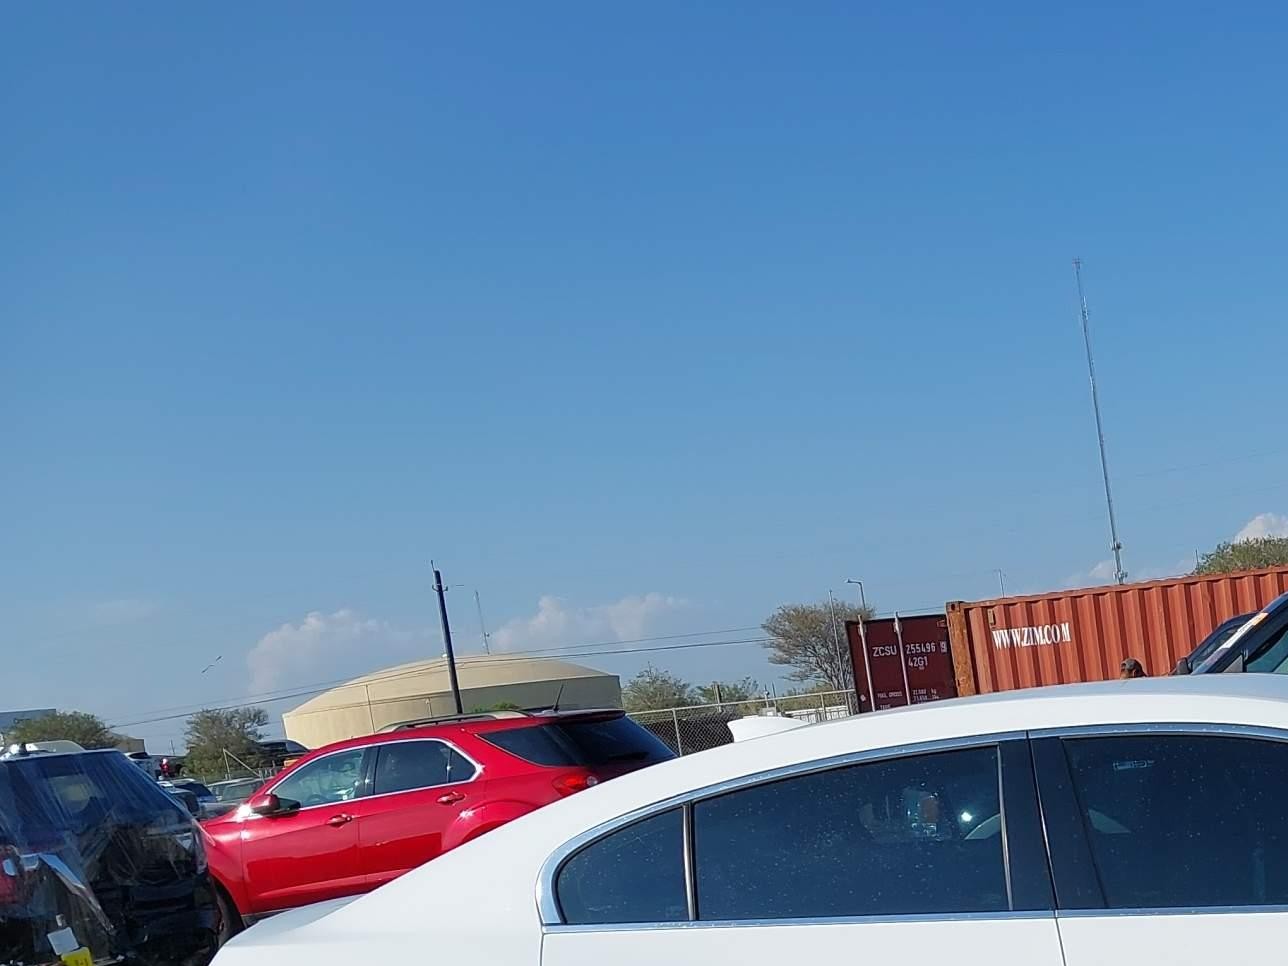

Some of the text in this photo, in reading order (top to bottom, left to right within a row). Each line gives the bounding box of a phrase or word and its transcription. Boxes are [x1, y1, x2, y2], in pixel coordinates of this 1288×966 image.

[872, 646, 897, 657] ZCSU
[905, 642, 936, 655] 255496
[908, 656, 928, 667] 42G1
